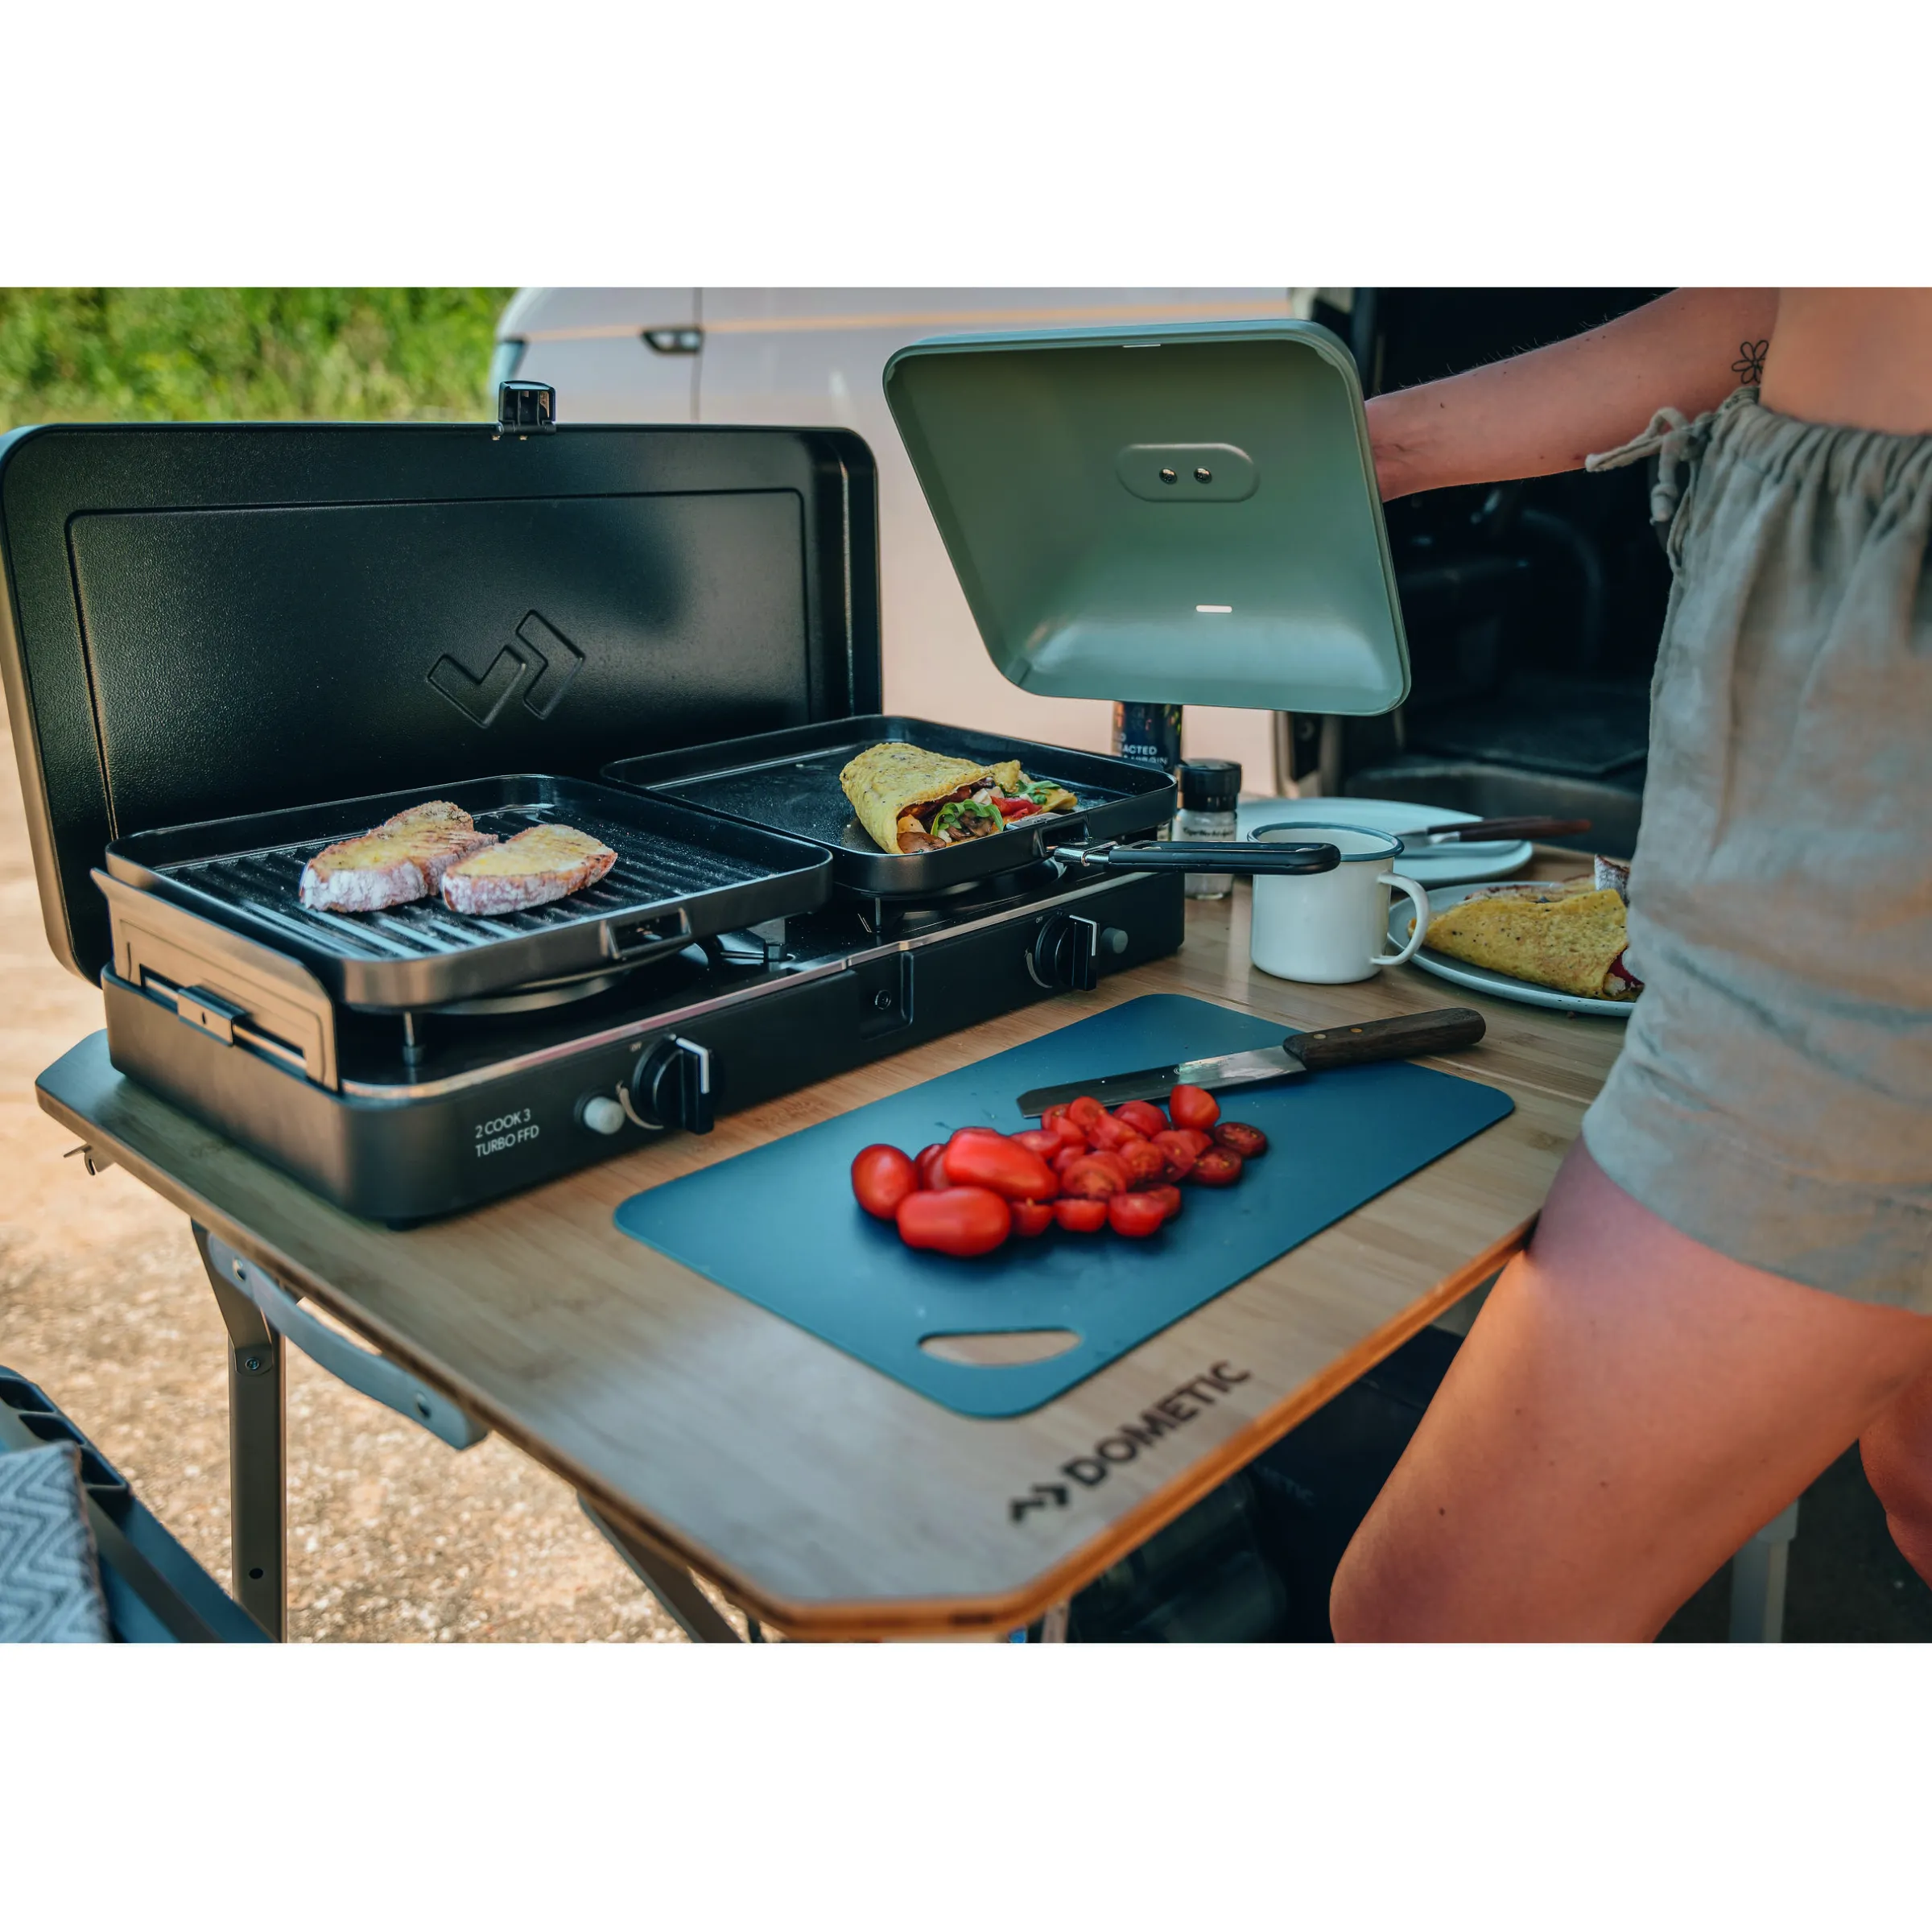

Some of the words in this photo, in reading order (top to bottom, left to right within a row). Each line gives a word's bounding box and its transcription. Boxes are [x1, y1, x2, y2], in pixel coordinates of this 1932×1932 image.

[475, 1125, 483, 1138] 2
[485, 1111, 522, 1135] COOK
[523, 1108, 531, 1122] 3
[475, 1133, 516, 1158] TURBO
[517, 1125, 539, 1143] FFD
[1061, 1360, 1252, 1489] DOMETIC
